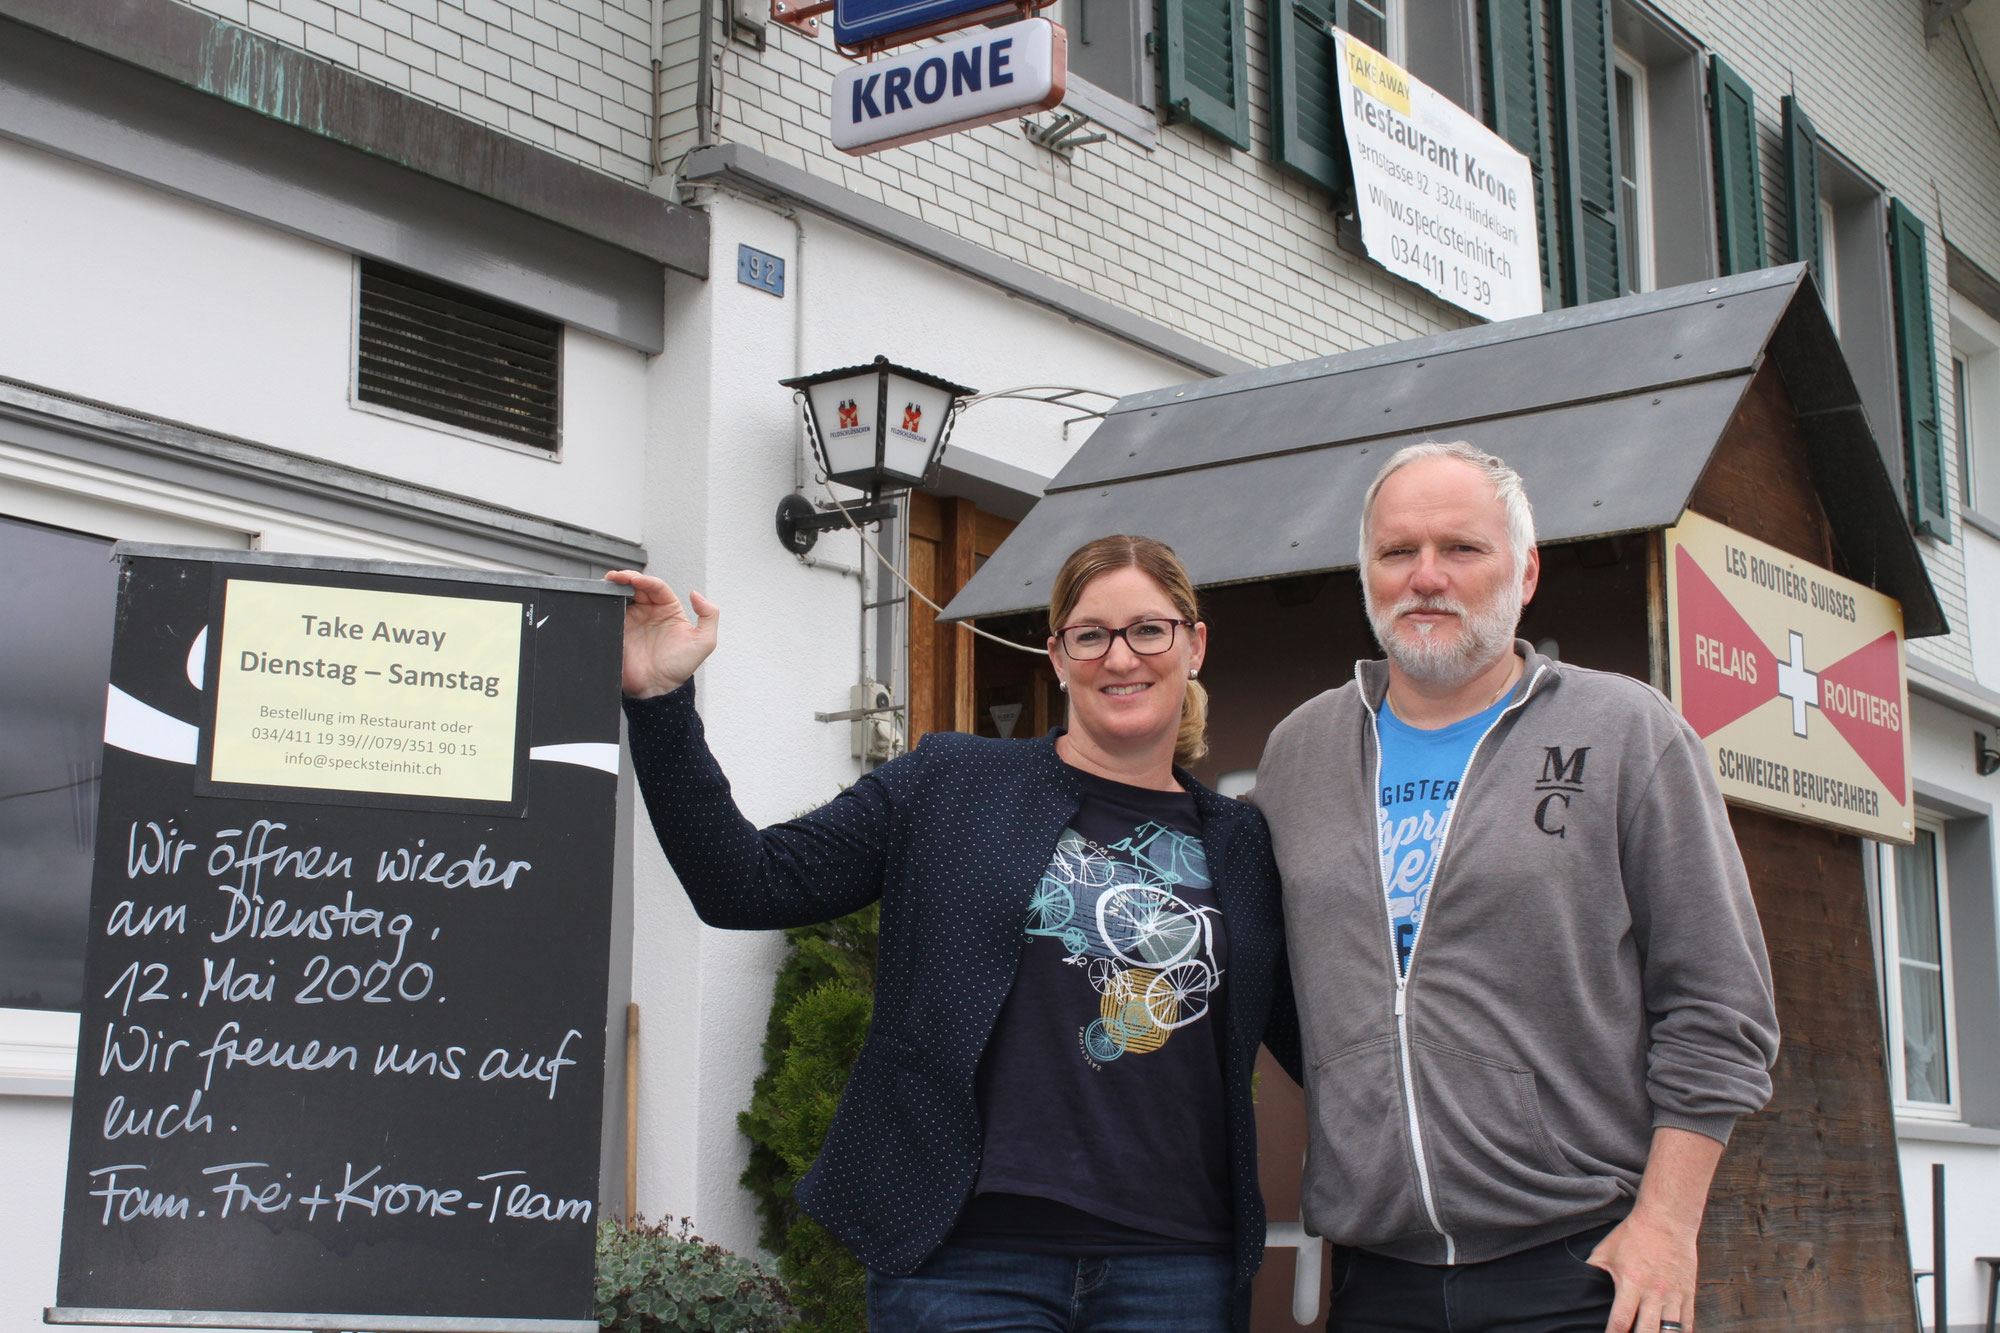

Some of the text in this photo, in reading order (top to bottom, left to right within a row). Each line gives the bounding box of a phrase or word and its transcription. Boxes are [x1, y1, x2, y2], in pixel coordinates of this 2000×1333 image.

[852, 38, 1014, 124] KRONE
[1348, 51, 1410, 101] TAKE AWAY
[1352, 84, 1517, 211] Restaurant Krone
[749, 255, 775, 287] 92
[1453, 266, 1468, 295] 19
[1472, 275, 1491, 305] 39
[1725, 544, 1856, 623] LES ROUTIERS SUISSES
[301, 614, 447, 652] Take Away
[239, 650, 358, 686] Dienstag
[388, 663, 501, 698] Samstag
[1695, 633, 1900, 733] RELAIS ROUTIERS
[251, 726, 311, 743] 034/411
[316, 732, 334, 745] 19
[438, 742, 456, 755] 90
[460, 743, 478, 757] 15
[259, 705, 473, 734] Bestellung im Restaurant oder
[284, 751, 442, 776] info@specksteinhit.ch
[1536, 745, 1592, 785] M
[1718, 747, 1880, 818] SCHWEIZER BERUFSFAHRER
[1533, 792, 1571, 839] C
[126, 818, 533, 901] Wir öffnen wieder
[106, 899, 186, 937] am
[104, 954, 446, 1017] 12. Mai 2020.
[98, 1020, 583, 1100] Wir freuen uns auf
